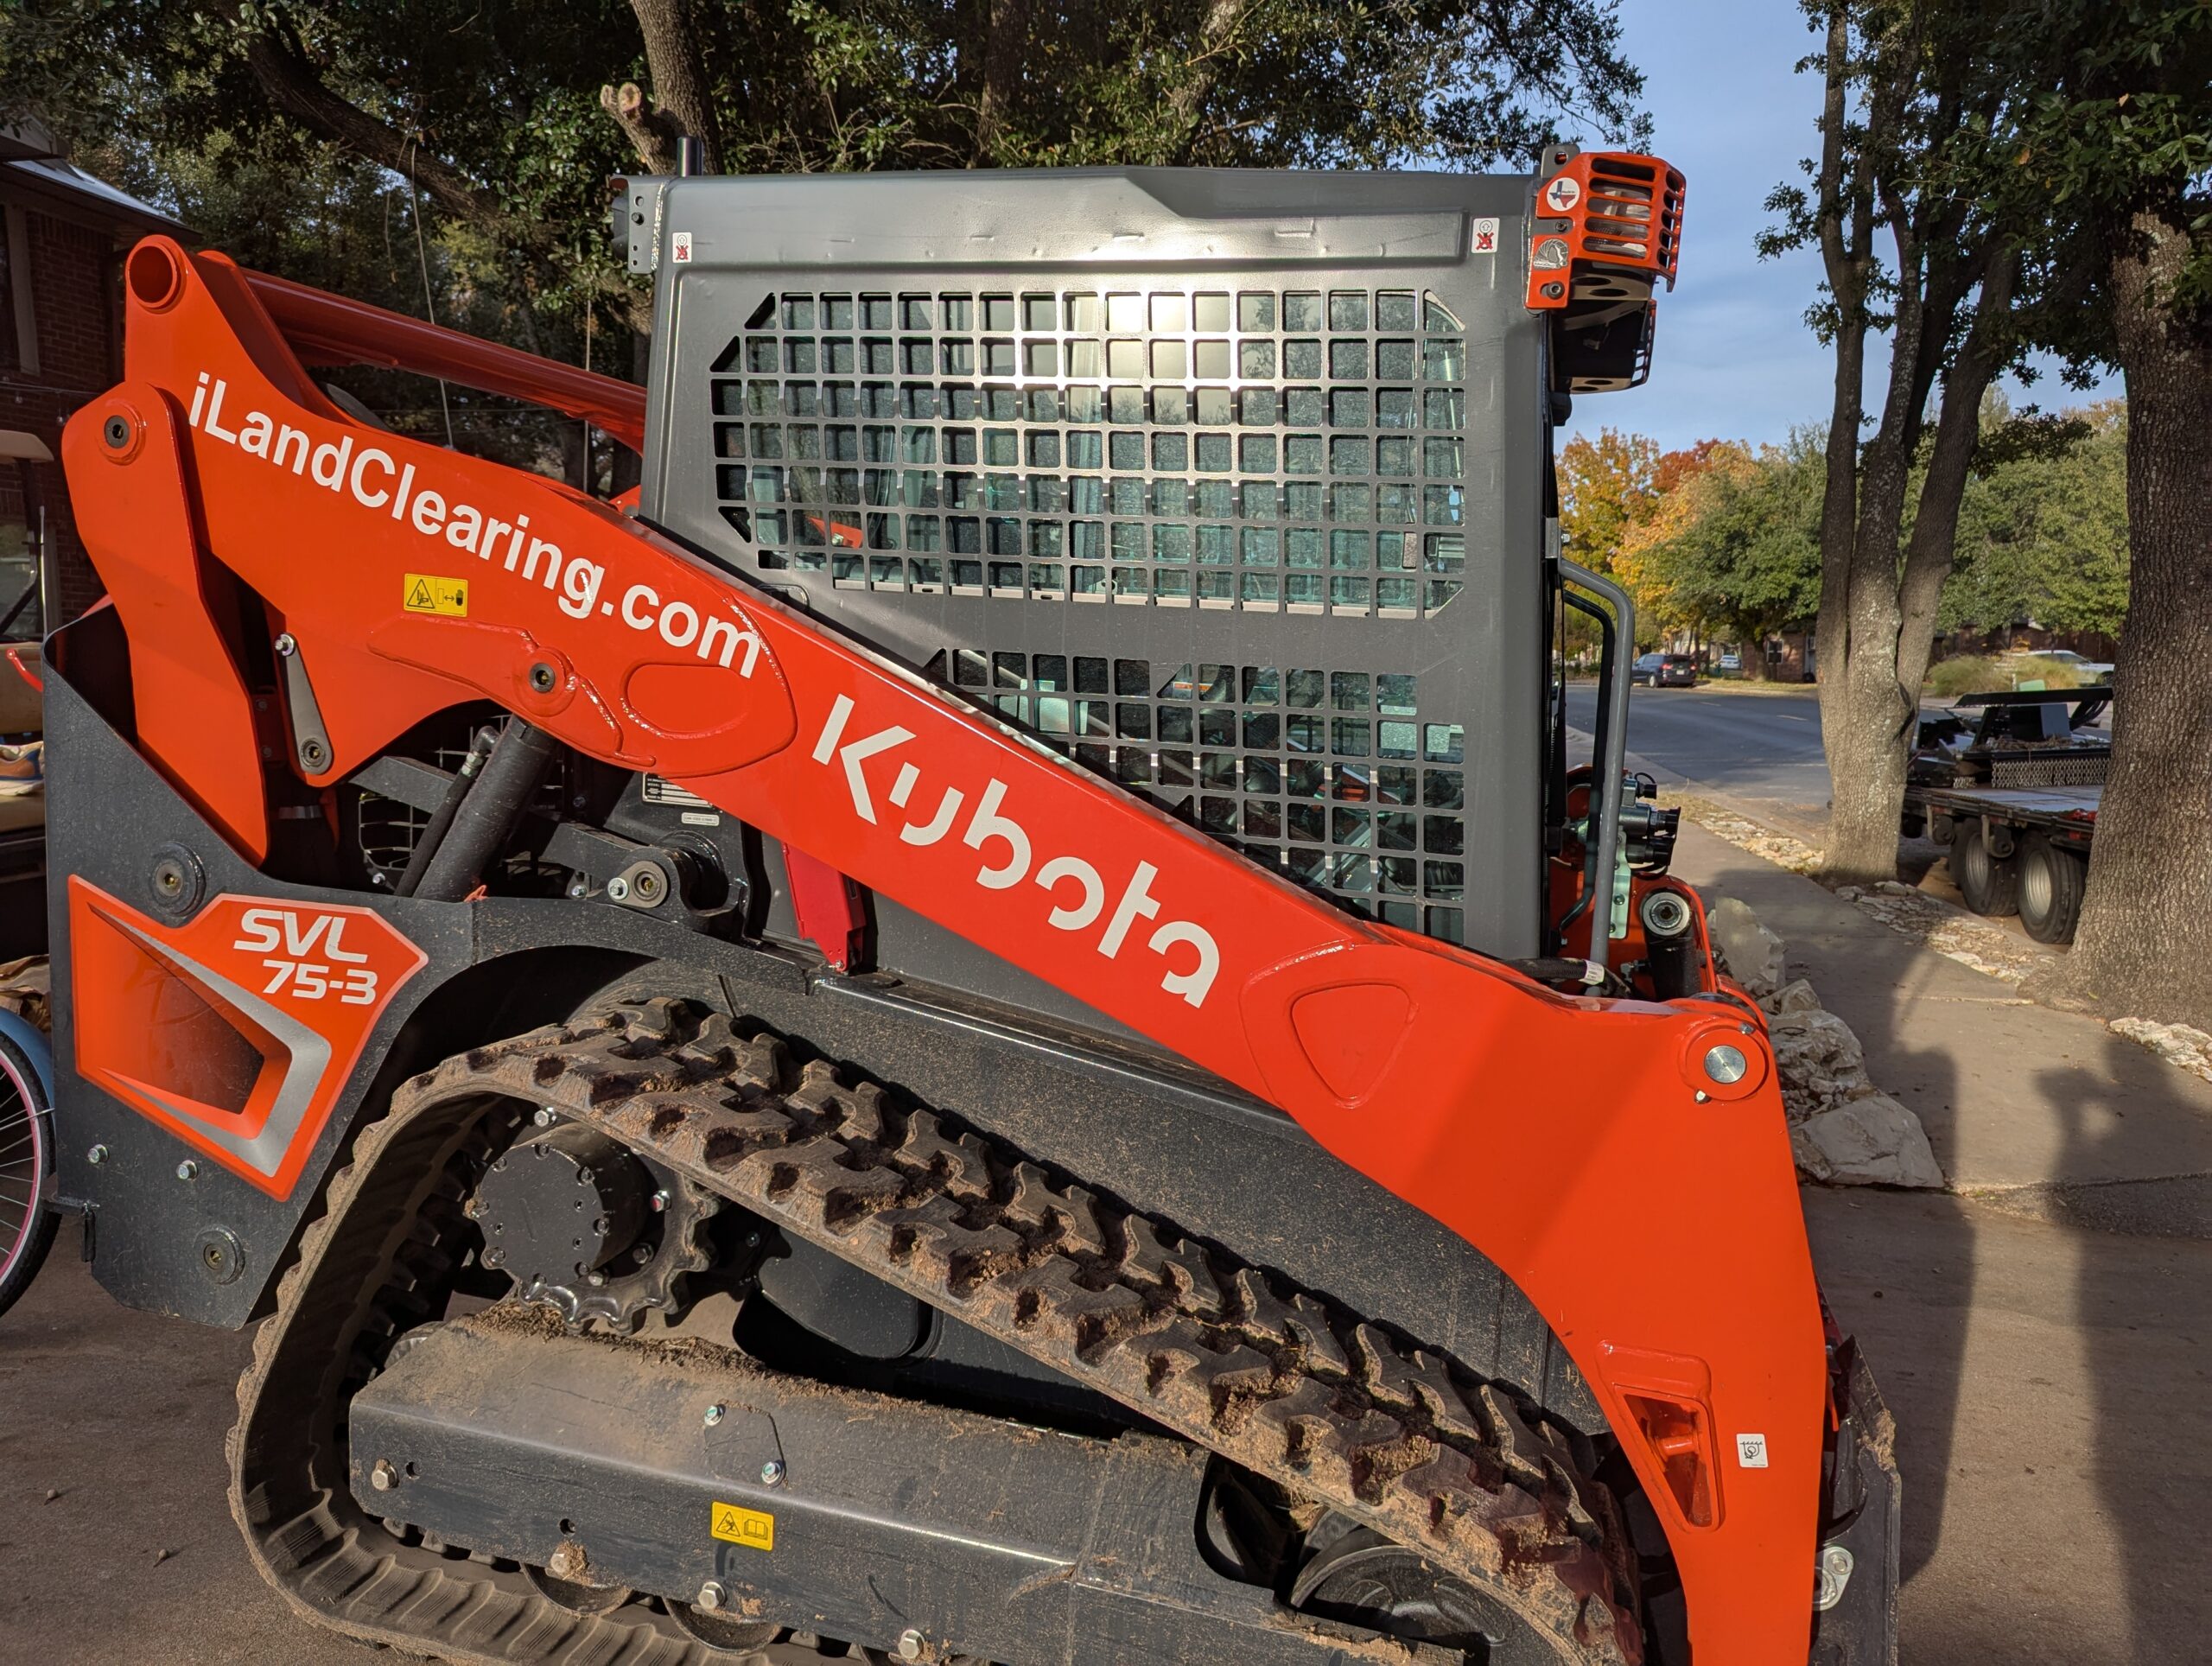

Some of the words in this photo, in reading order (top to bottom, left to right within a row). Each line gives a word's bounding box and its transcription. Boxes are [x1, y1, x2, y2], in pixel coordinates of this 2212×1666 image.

[188, 372, 761, 679] iLandClearing.com
[233, 908, 368, 963] SVL
[811, 693, 1220, 1008] Kubota
[262, 959, 378, 1005] 75-3
